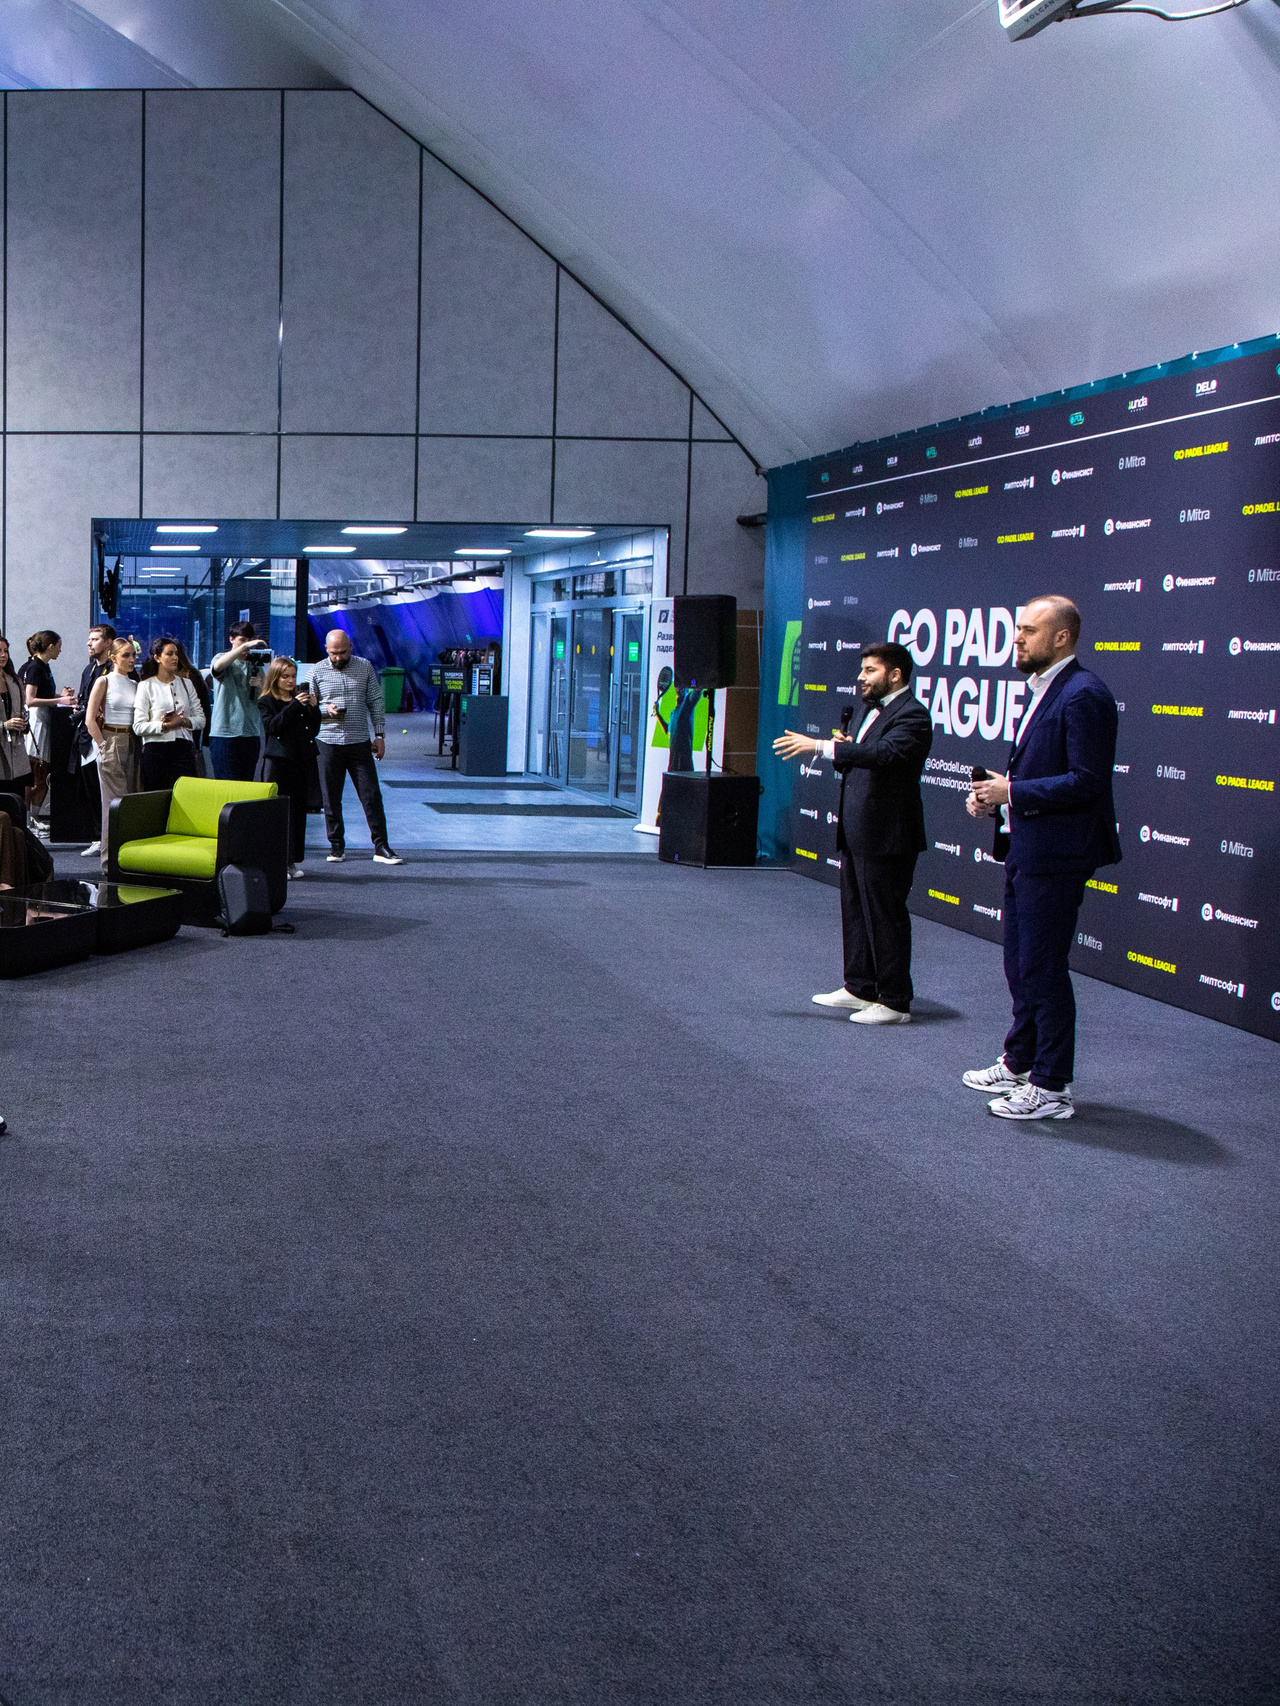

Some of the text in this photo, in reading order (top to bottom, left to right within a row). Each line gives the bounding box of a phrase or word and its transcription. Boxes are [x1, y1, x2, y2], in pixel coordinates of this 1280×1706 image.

[1125, 456, 1146, 469] Mitra
[1187, 509, 1210, 522] Mitra
[1176, 576, 1216, 587] Финансист
[888, 608, 938, 666] GO
[1162, 640, 1198, 653] липтсофт
[1243, 640, 1280, 651] Финанси
[915, 676, 1026, 742] EAGUE
[1152, 704, 1204, 716] GO PADEL LEAGUE
[1228, 710, 1268, 723] липтсофт
[1164, 766, 1186, 780] Mitra
[1216, 775, 1275, 791] GO PADEL LEAGUE
[1152, 830, 1190, 846] Финансист
[1229, 841, 1253, 857] Mitra
[1085, 880, 1098, 891] ADEL
[1138, 892, 1172, 909] липтсофт
[1215, 909, 1258, 928] Финансист
[1083, 934, 1102, 950] Mitra
[1199, 974, 1238, 994] липтсофт
